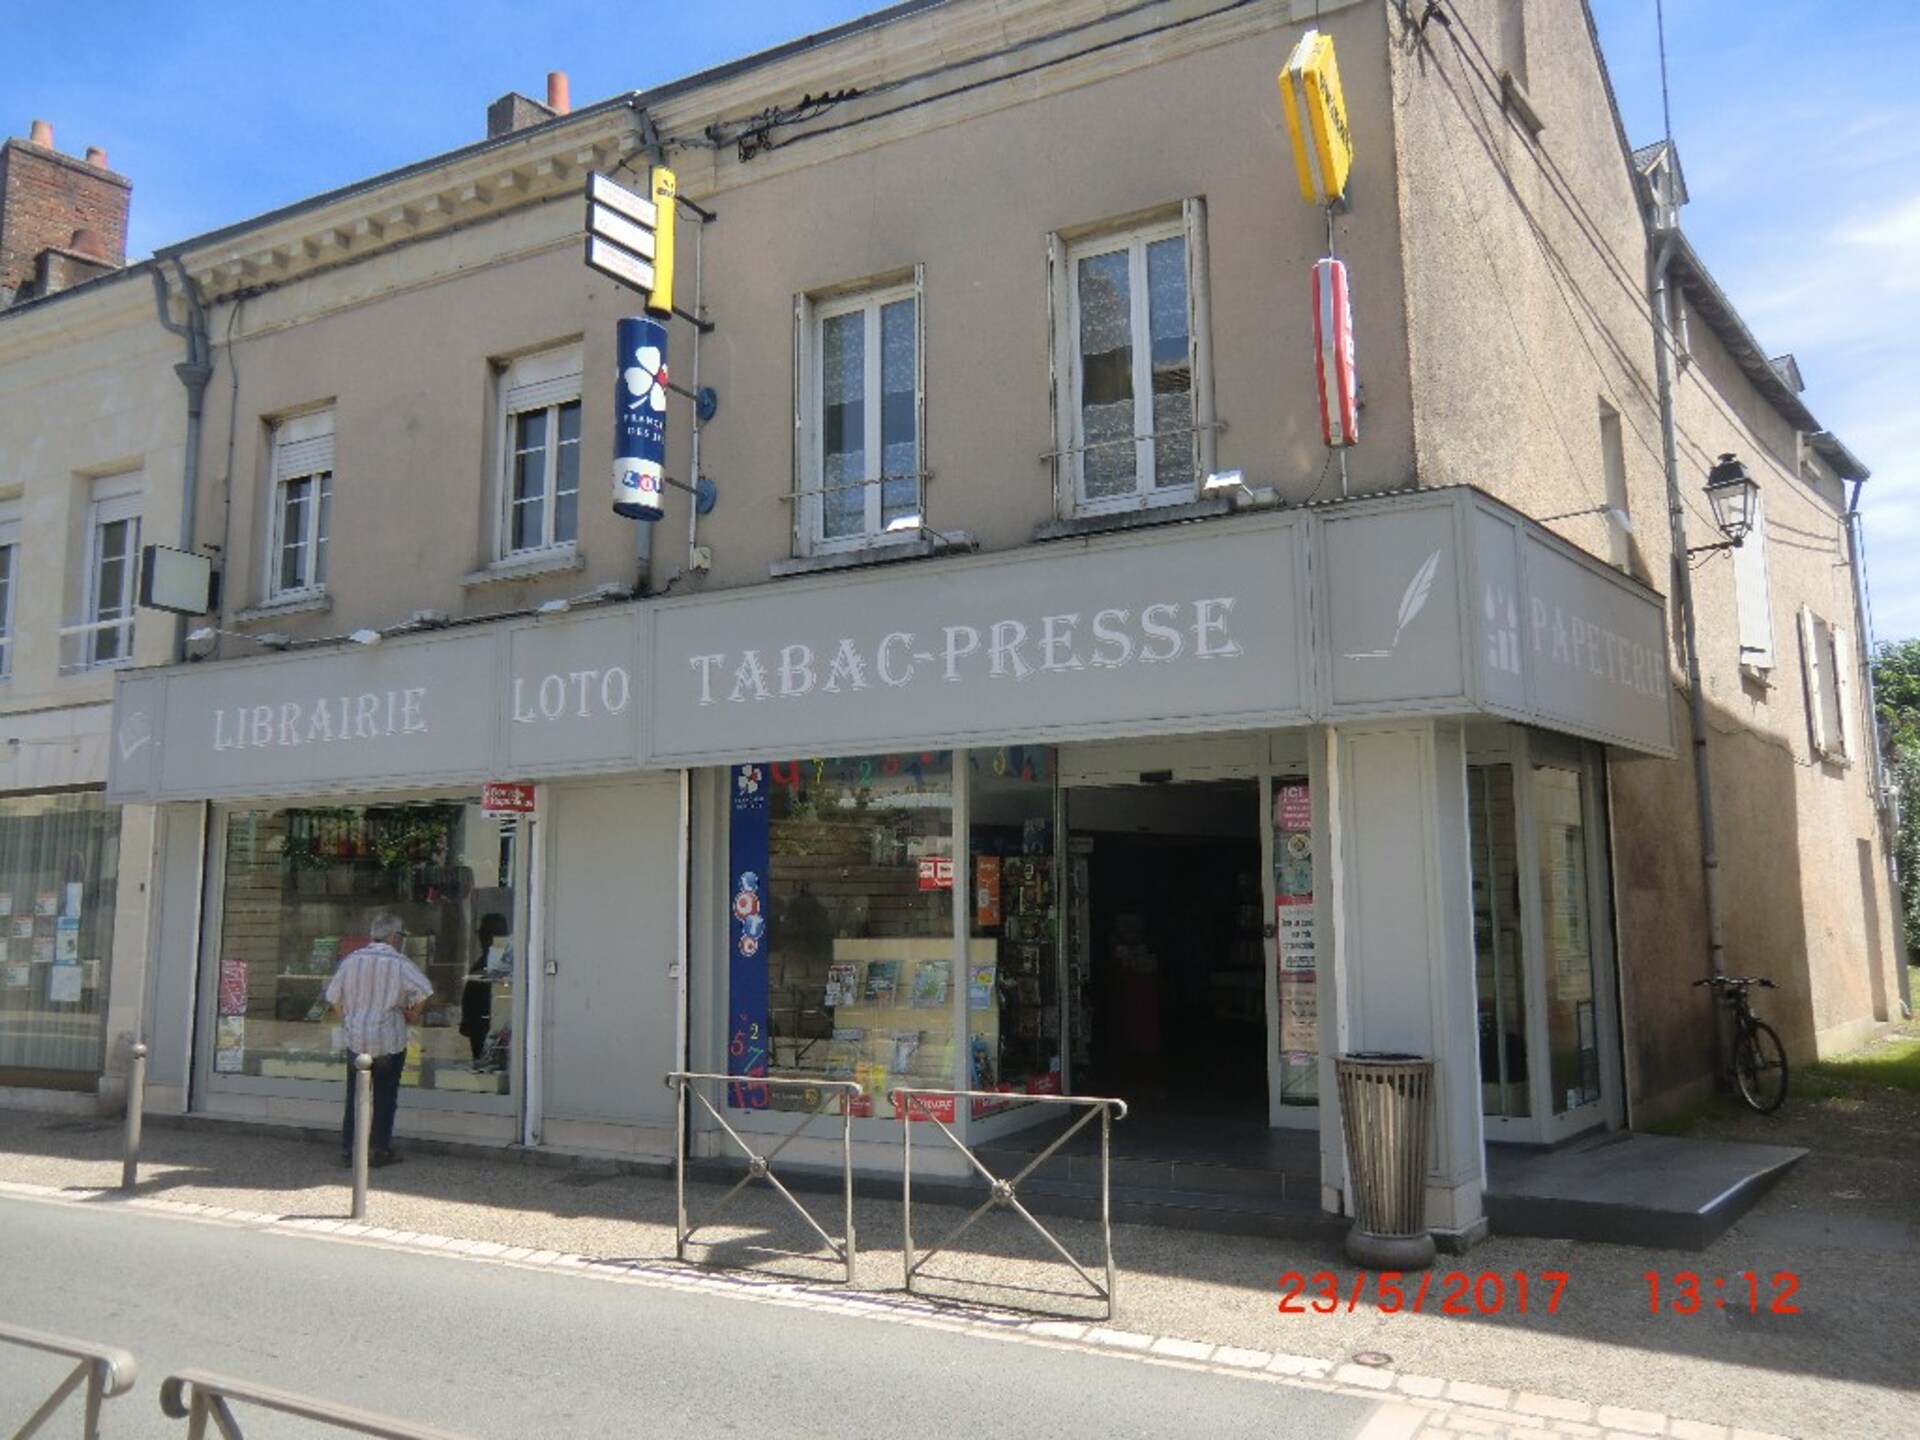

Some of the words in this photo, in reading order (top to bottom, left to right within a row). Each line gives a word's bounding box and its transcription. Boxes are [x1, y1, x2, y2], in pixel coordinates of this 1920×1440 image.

[689, 597, 1244, 706] TABAC-PRESSE
[1530, 596, 1667, 699] PAPETERIE
[213, 686, 428, 752] LIBRAIRIE
[511, 666, 632, 723] LOTO
